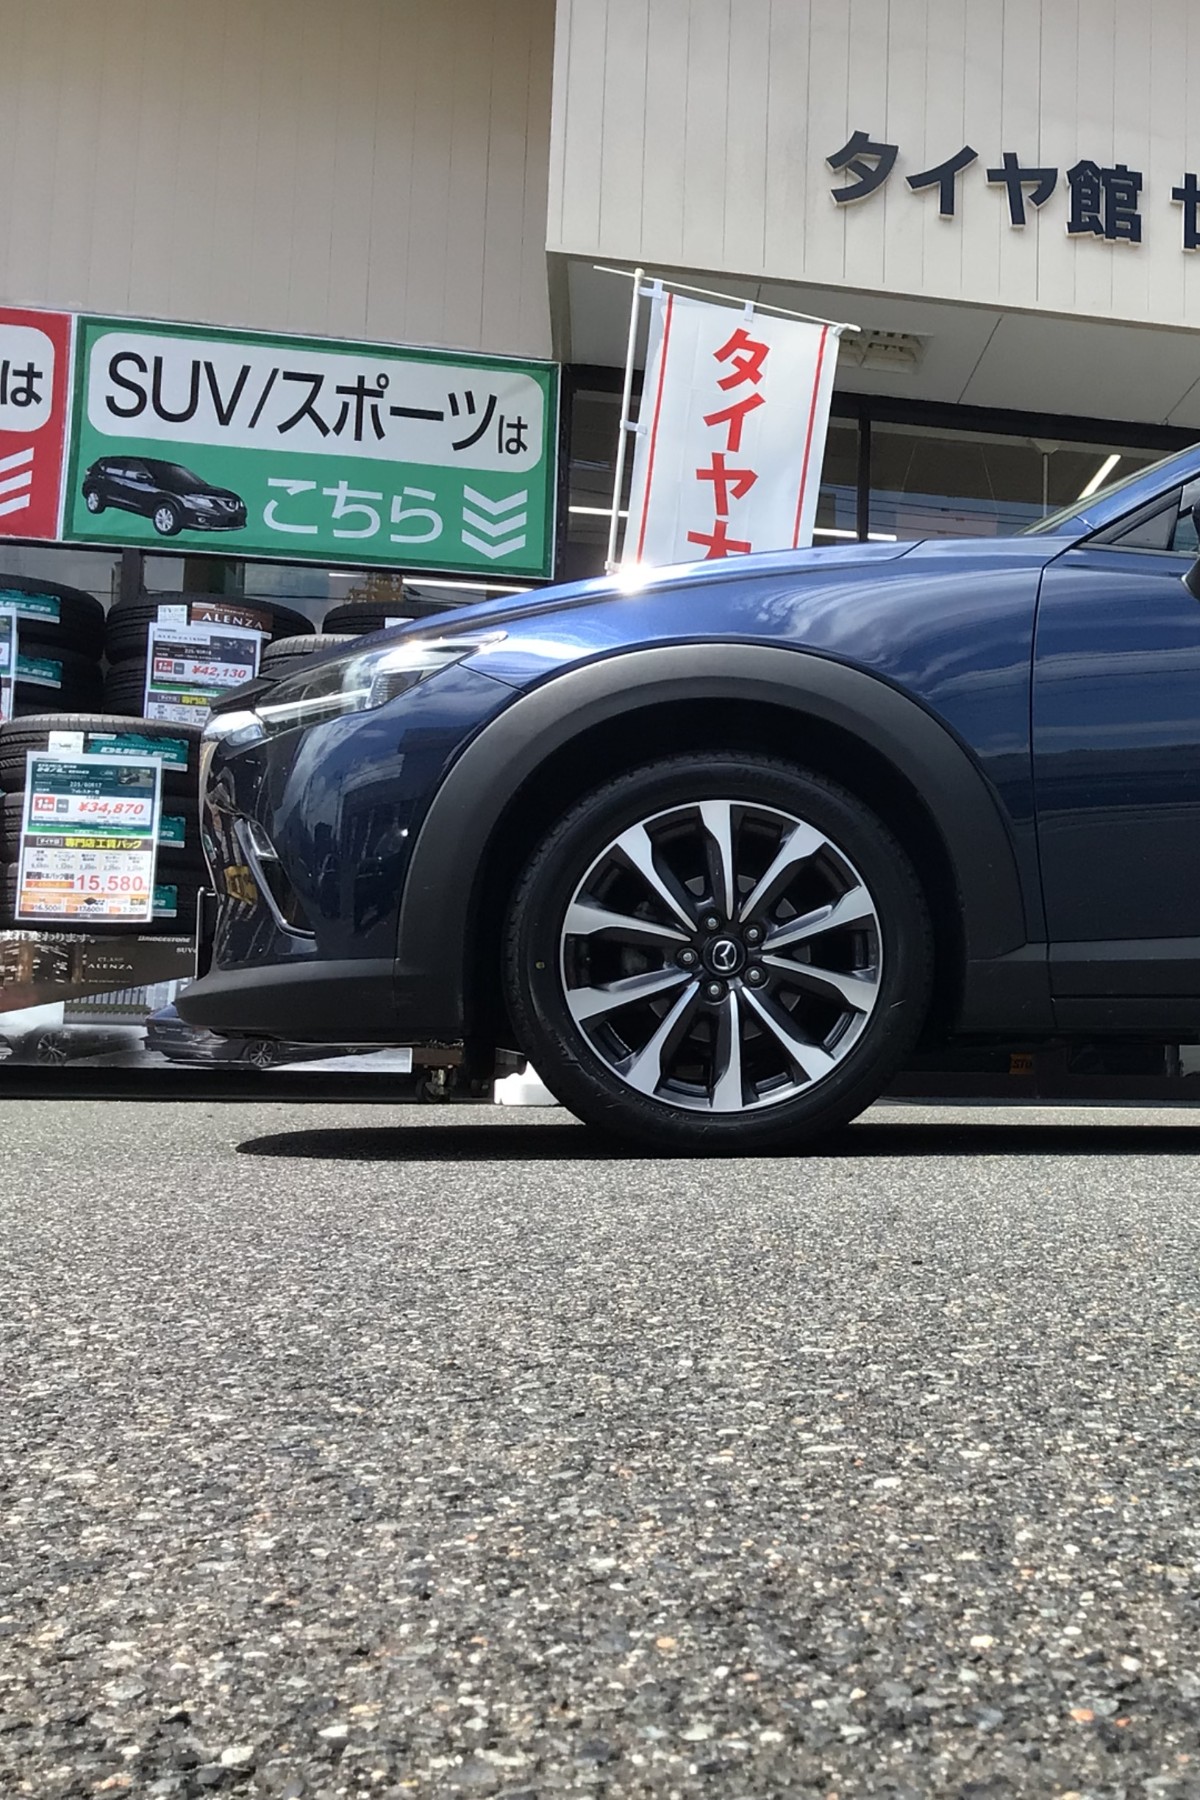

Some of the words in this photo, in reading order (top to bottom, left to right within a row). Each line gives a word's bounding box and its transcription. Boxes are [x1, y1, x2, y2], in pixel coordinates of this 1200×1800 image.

[825, 129, 1142, 246] タイヤ館
[105, 351, 529, 455] SUV/スポーツは
[263, 477, 444, 544] こちら
[202, 612, 263, 631] ALENZA
[192, 665, 247, 679] ¥42,130
[78, 802, 144, 815] ¥34,870
